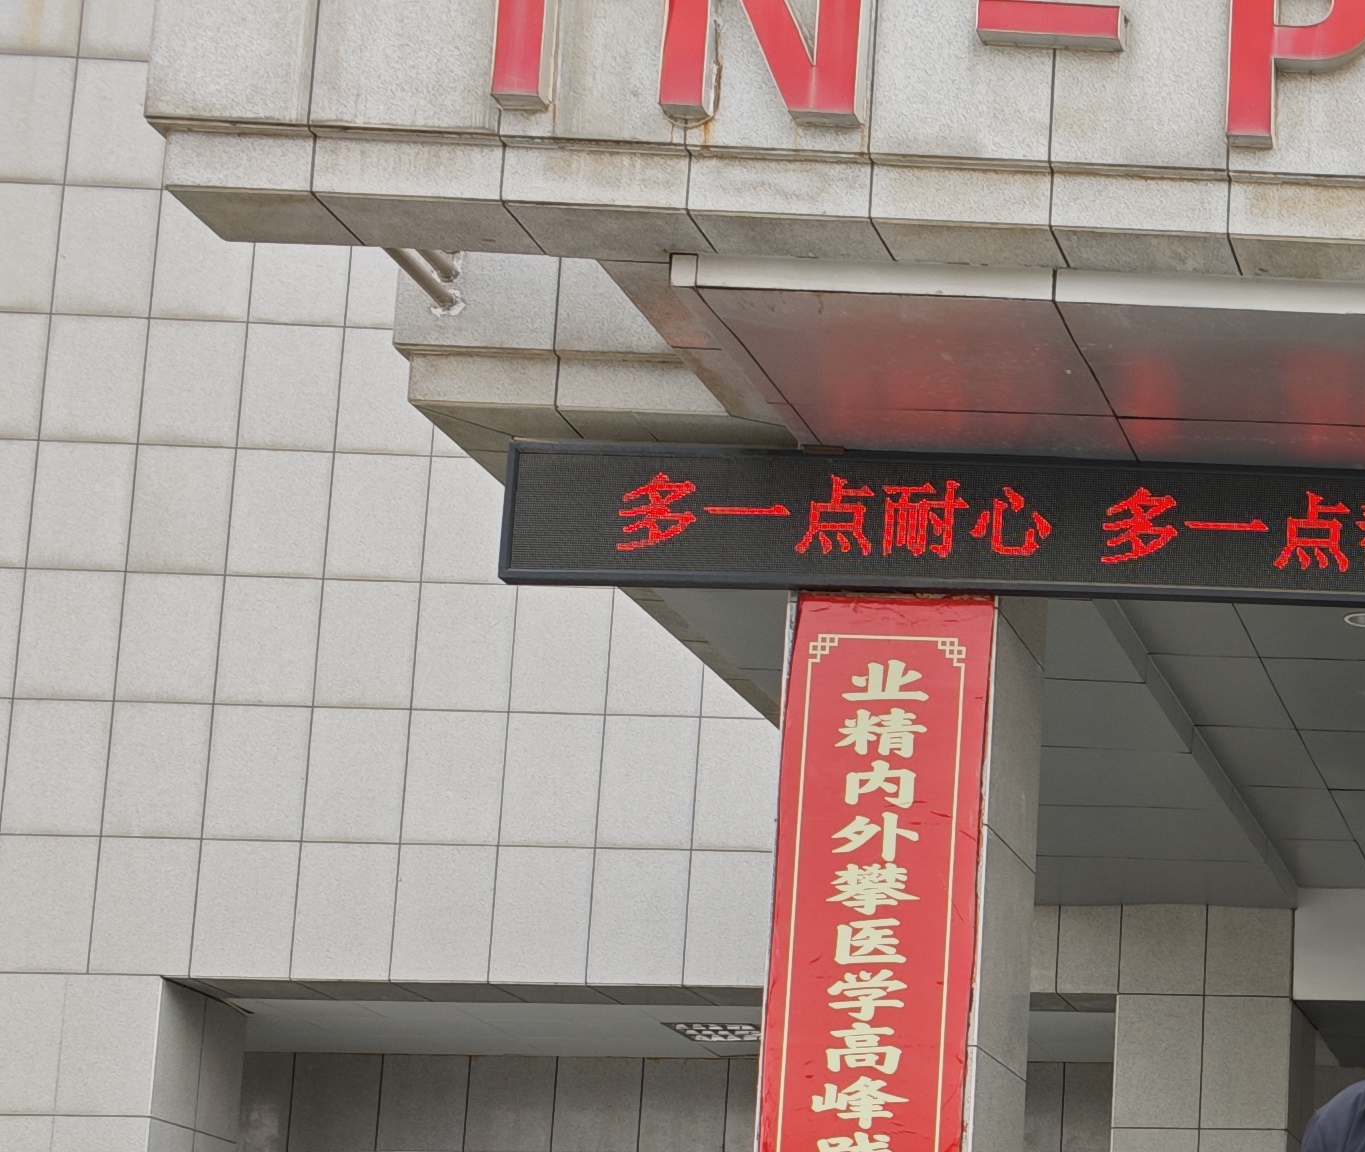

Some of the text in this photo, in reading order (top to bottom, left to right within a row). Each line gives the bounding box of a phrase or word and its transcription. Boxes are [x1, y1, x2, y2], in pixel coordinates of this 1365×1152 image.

[616, 473, 1052, 559] 多一点耐心
